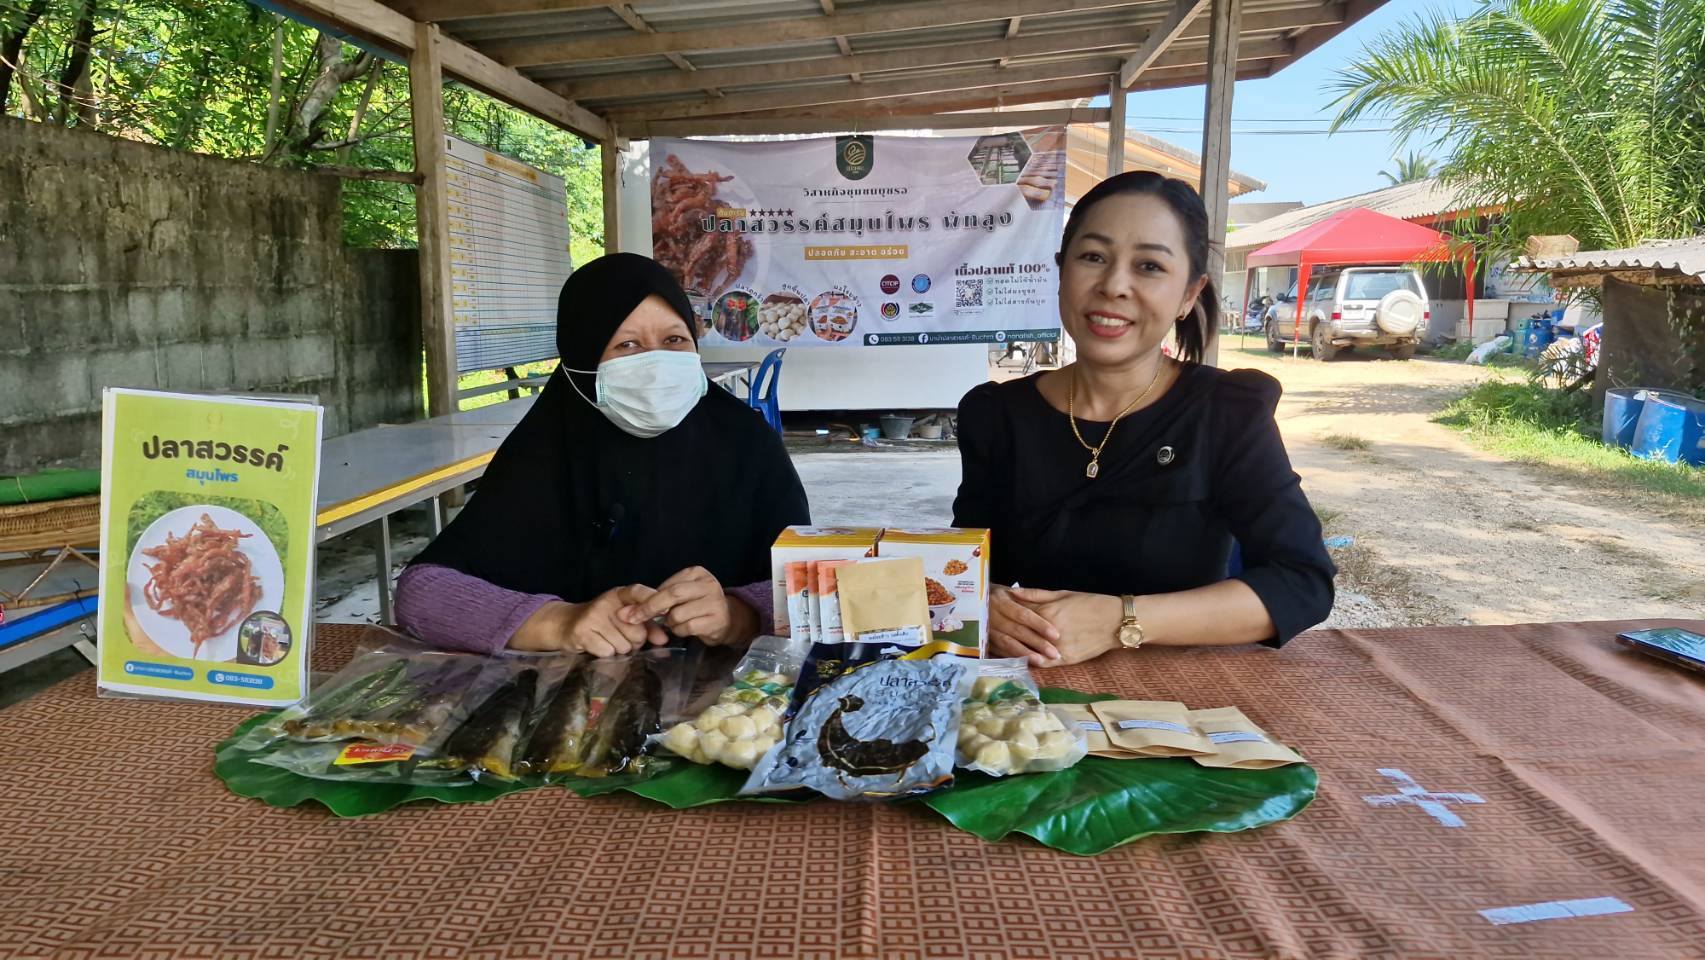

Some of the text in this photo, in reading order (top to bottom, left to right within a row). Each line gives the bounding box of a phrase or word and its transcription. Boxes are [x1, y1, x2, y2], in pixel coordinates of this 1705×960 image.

[944, 210, 1012, 231] พัทลุง
[808, 246, 905, 257] ปลอดภัย สะอาด อร่อย
[955, 263, 1051, 276] เนื้อปลาแท้ 100%
[142, 435, 289, 472] ปลาสวรรค์
[185, 467, 239, 485] สมุนไพร
